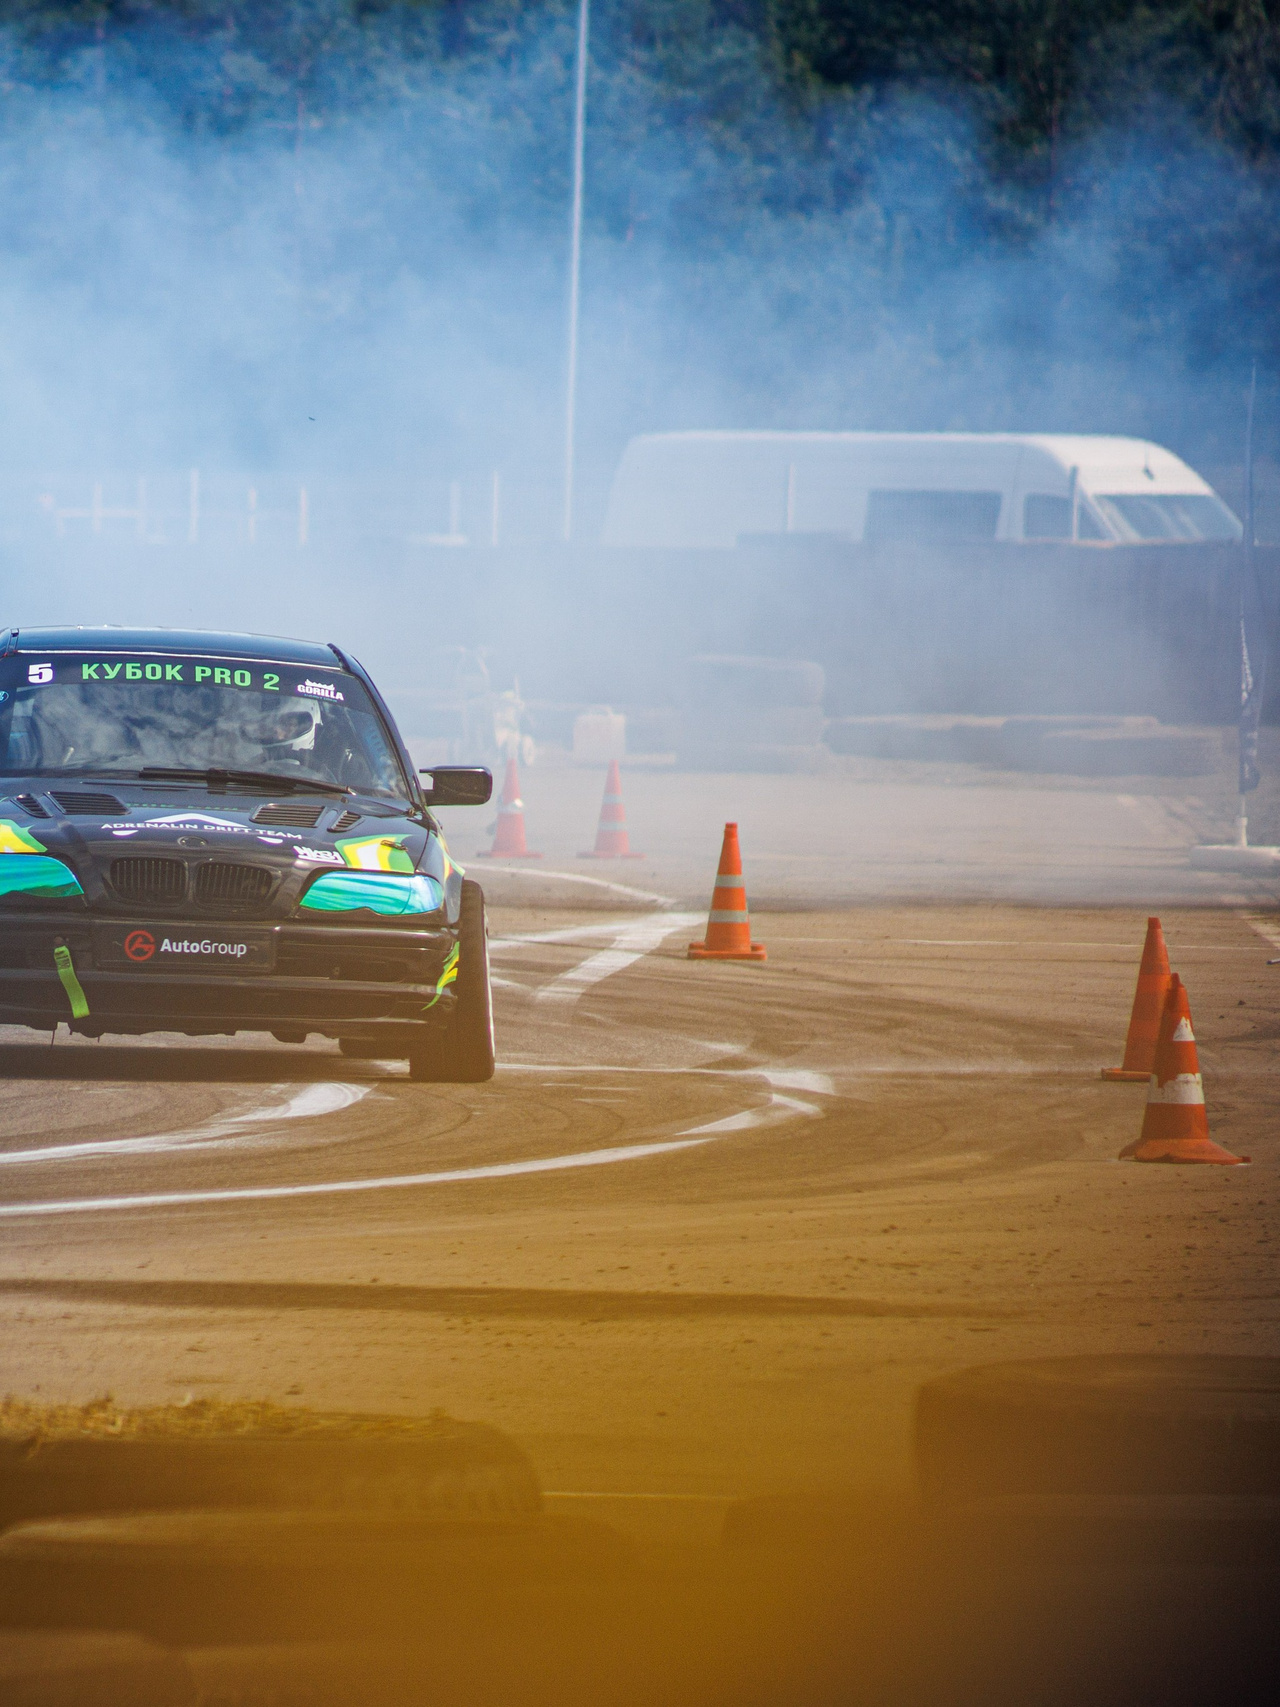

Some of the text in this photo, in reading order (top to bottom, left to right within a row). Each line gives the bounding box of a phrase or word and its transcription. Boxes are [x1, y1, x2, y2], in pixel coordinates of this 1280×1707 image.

[28, 663, 53, 684] 5
[82, 663, 280, 691] КУБОК PRO 2
[297, 684, 344, 701] GORILLA
[203, 825, 252, 833] DRIFT
[255, 829, 302, 839] TEAM
[160, 939, 247, 957] AutoGroup
